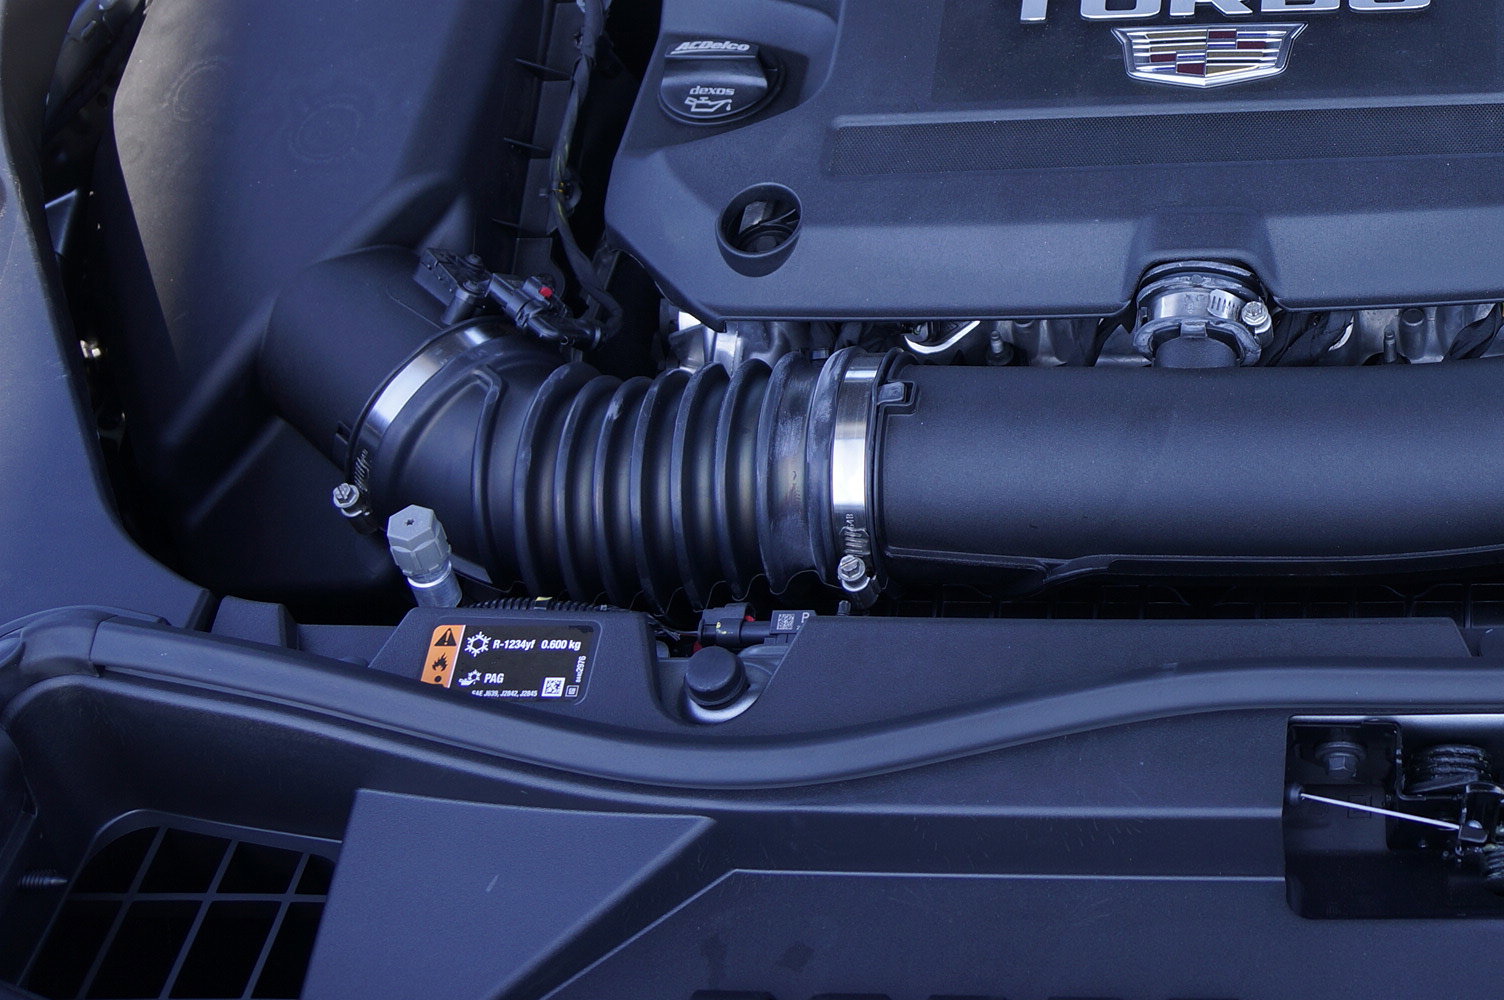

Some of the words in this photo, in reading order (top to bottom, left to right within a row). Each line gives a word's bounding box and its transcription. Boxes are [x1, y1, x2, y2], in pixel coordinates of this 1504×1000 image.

[674, 40, 750, 51] ACDelco
[688, 85, 736, 96] dexos
[492, 639, 536, 651] R-1234yf
[541, 640, 567, 649] 0.600
[568, 640, 582, 651] kg
[483, 673, 505, 684] PAG
